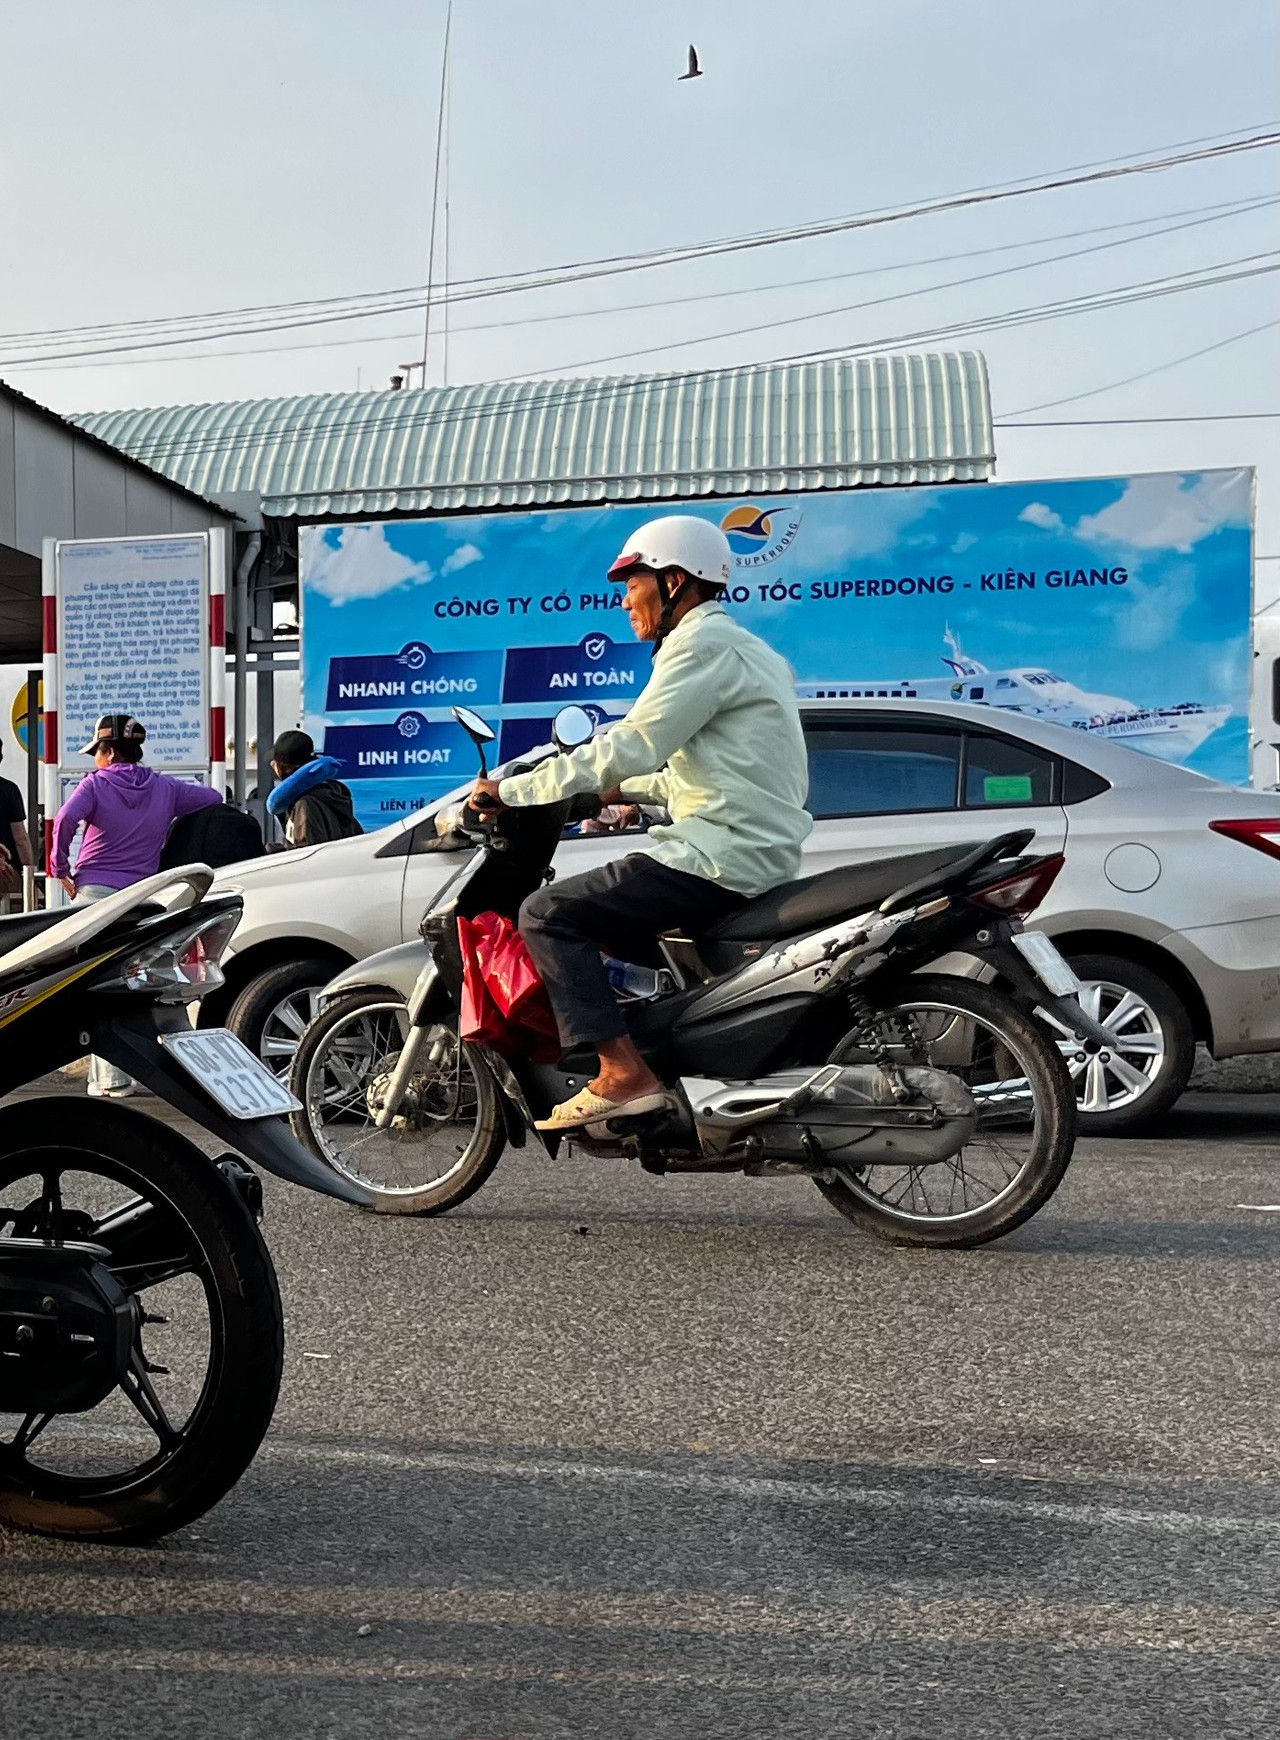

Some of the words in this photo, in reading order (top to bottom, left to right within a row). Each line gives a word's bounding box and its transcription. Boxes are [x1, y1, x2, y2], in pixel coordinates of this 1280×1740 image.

[735, 522, 798, 567] SUPERDONG
[434, 596, 500, 618] CÔNG
[507, 597, 532, 614] TY
[540, 589, 571, 613] CỔ
[580, 587, 624, 611] PHẦ
[716, 586, 749, 603] AO
[758, 578, 802, 602] TỐC
[810, 576, 955, 600] SUPERDONG
[981, 568, 1035, 591] KIÊN
[1045, 567, 1128, 588] GIANG
[338, 681, 406, 698] NHANH
[410, 675, 478, 695] CHÓNG
[549, 673, 578, 688] AN
[583, 667, 634, 686] TOÀN
[358, 751, 398, 766] LINH
[404, 749, 451, 767] HOẠT
[381, 798, 406, 811] LIÊN
